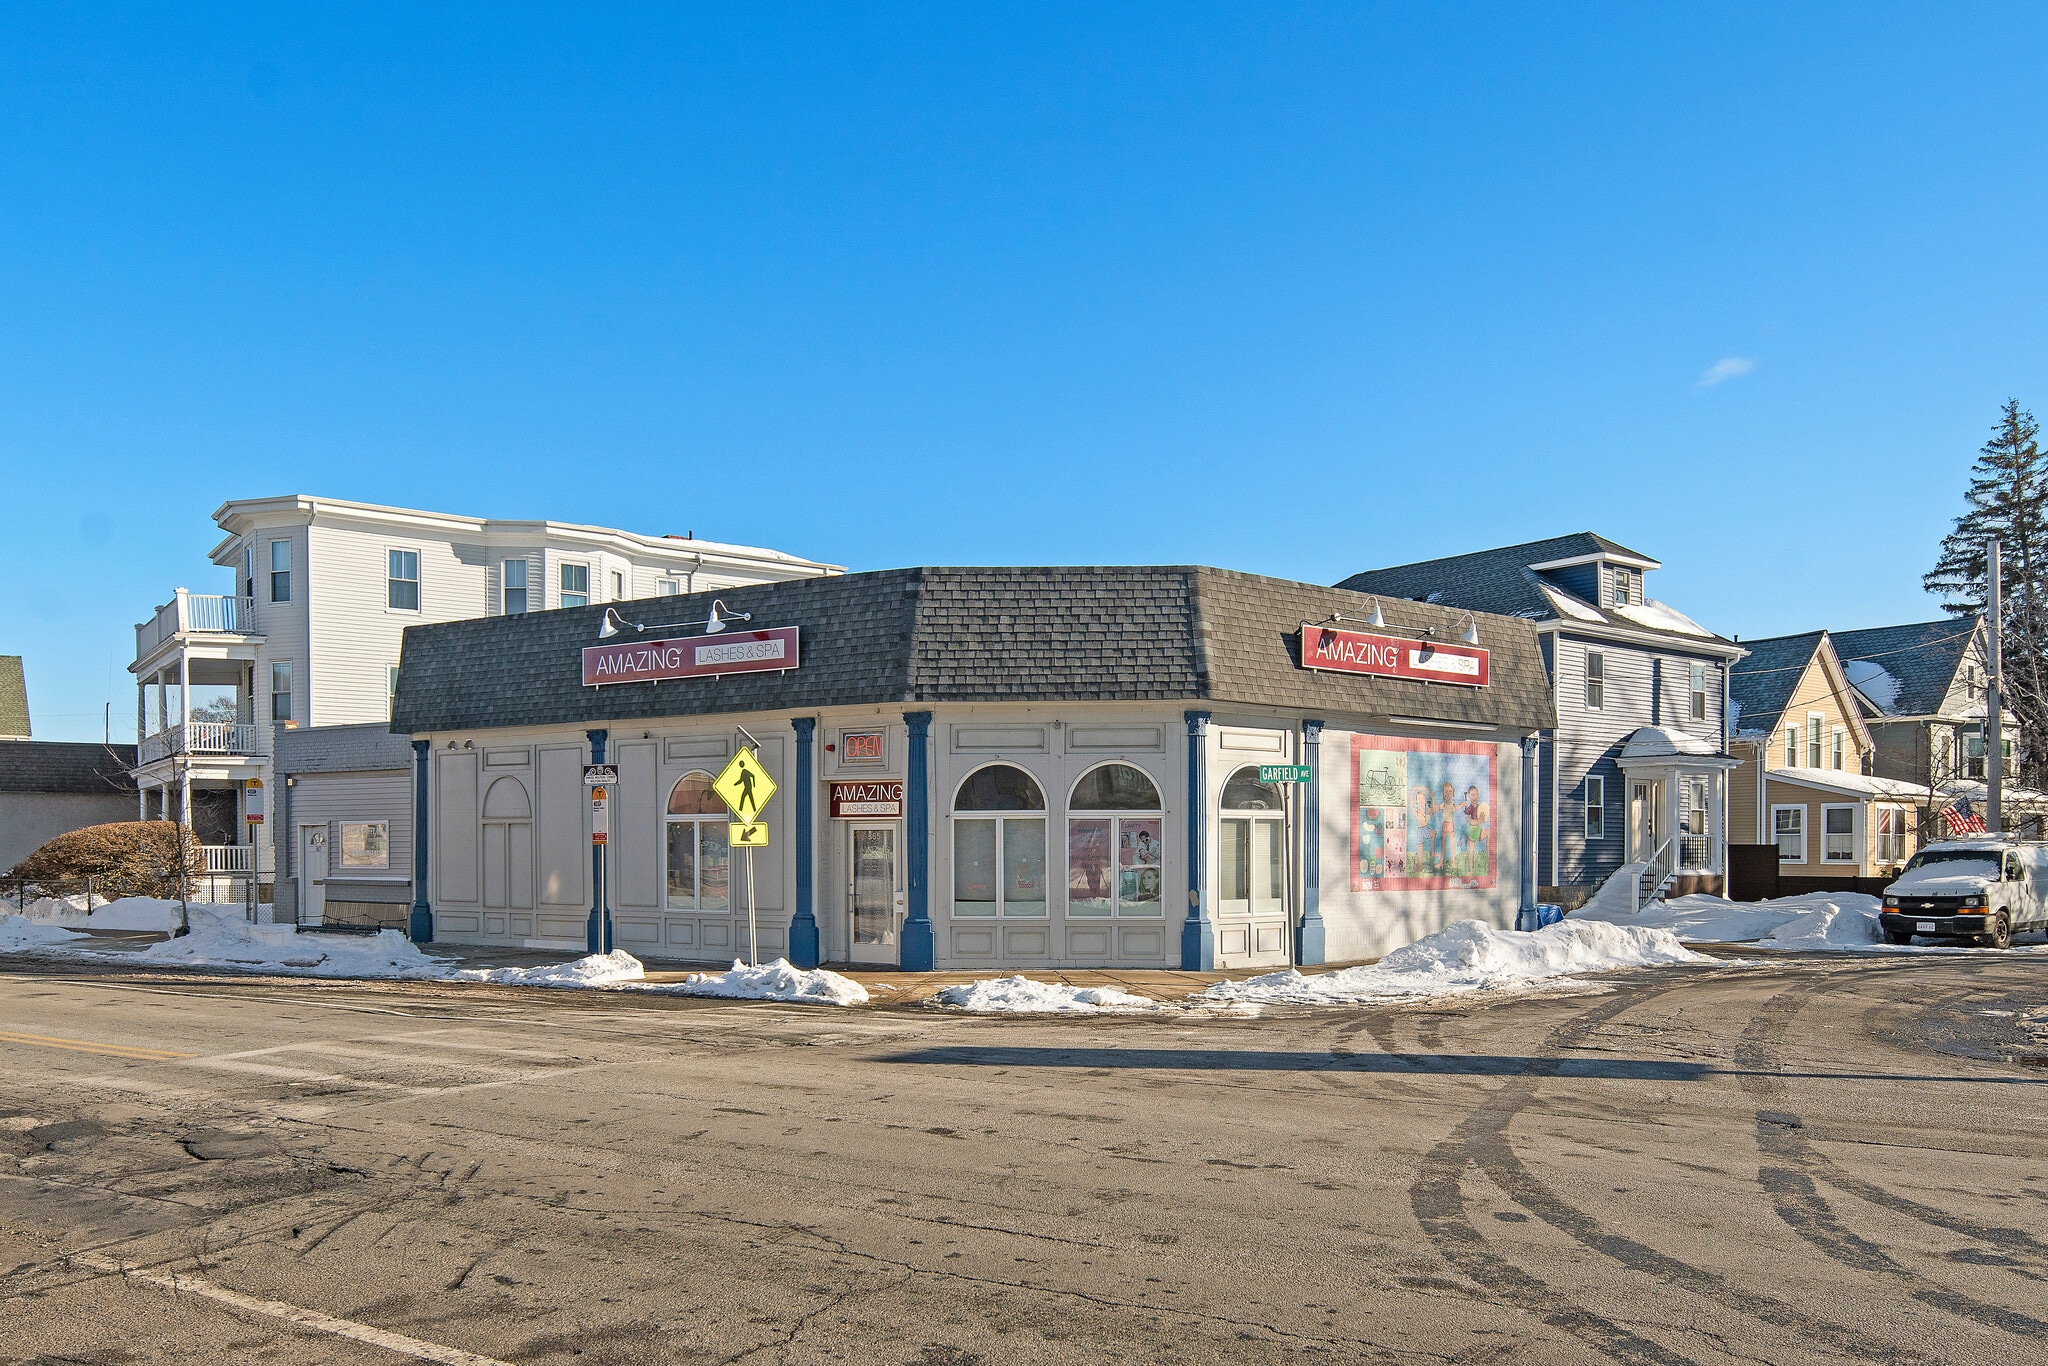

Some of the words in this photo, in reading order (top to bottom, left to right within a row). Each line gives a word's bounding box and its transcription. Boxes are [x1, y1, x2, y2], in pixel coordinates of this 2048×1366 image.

[596, 647, 682, 676] AMAZING
[699, 646, 746, 663] LASHES
[747, 645, 756, 658] &
[756, 643, 780, 658] SPA
[1316, 637, 1398, 668] AMAZING
[1458, 658, 1476, 673] SPA
[847, 735, 882, 757] OPEN
[1262, 767, 1298, 780] GARFIELD
[833, 784, 903, 801] AMAZING
[842, 804, 873, 813] LASHES
[874, 803, 879, 813] &
[880, 803, 896, 813] SPA
